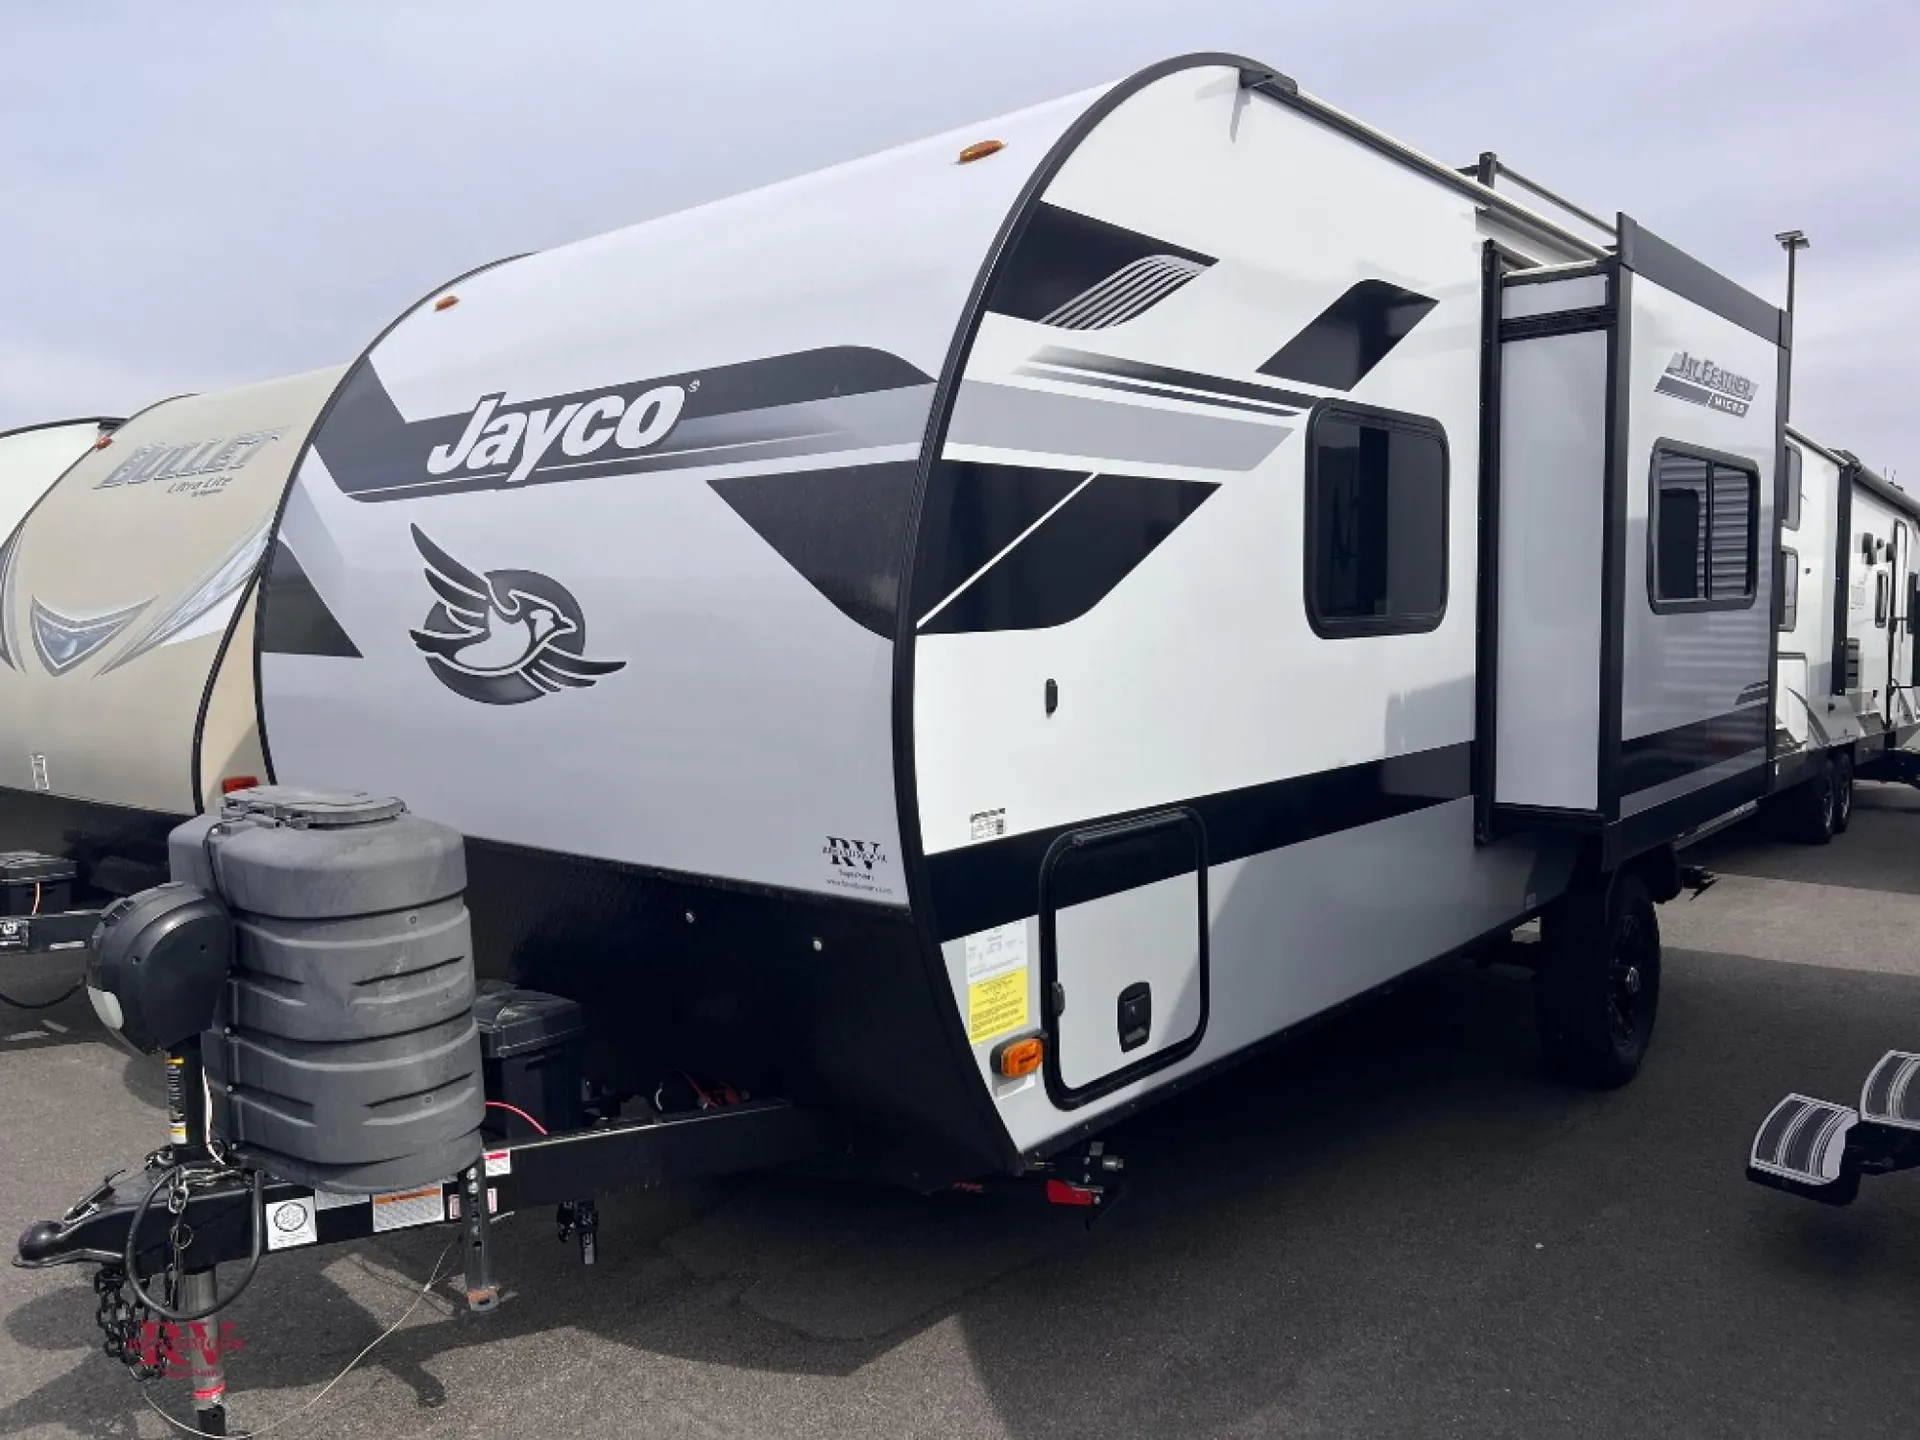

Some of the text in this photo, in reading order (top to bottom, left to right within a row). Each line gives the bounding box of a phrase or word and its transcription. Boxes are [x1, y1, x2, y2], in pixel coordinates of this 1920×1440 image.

[92, 426, 292, 490] BULLET
[426, 385, 685, 482] Jayco
[825, 835, 881, 870] RV
